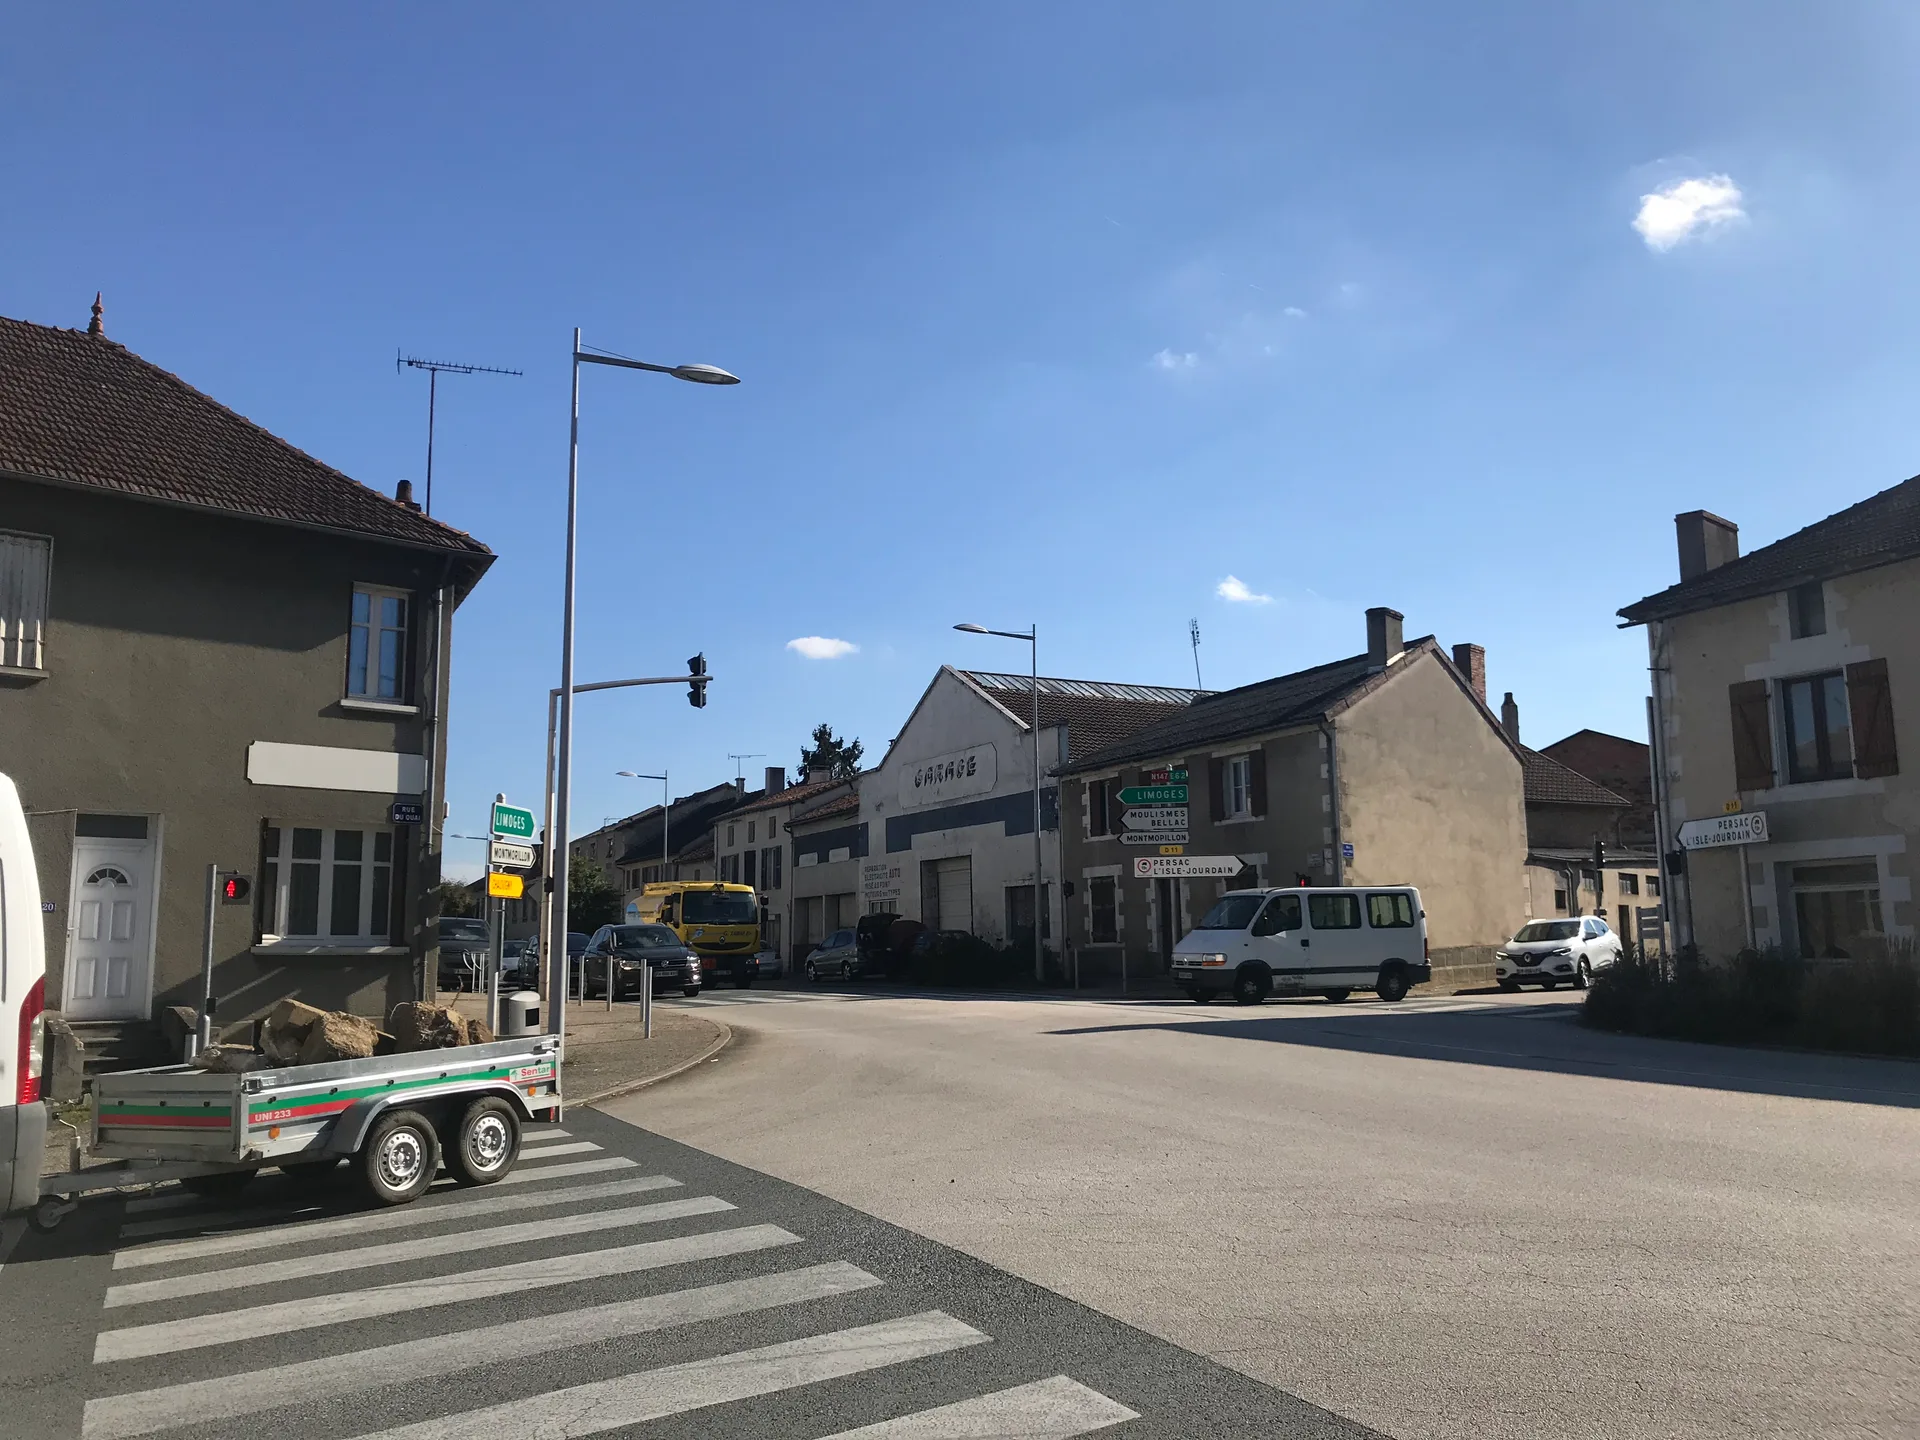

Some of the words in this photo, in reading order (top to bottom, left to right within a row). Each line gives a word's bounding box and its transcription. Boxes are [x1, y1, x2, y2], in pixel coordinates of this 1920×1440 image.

[915, 756, 976, 788] GARAGE
[1151, 772, 1168, 780] N147
[1169, 772, 1185, 780] E62
[1137, 789, 1184, 800] LIMOGES
[1130, 810, 1186, 818] MOULISMES
[496, 811, 525, 830] LIMOGES
[1151, 819, 1186, 827] BELLAC
[1718, 817, 1749, 830] PERSAC
[1686, 830, 1751, 846] L'ISLE-JOURDAIN
[494, 847, 531, 862] MONTMORILLON
[1153, 866, 1233, 875] L'ISLE-JOURDAIN
[42, 902, 54, 911] 20
[521, 1066, 550, 1077] Sentar
[254, 1111, 273, 1122] UNI
[274, 1109, 291, 1119] 233
